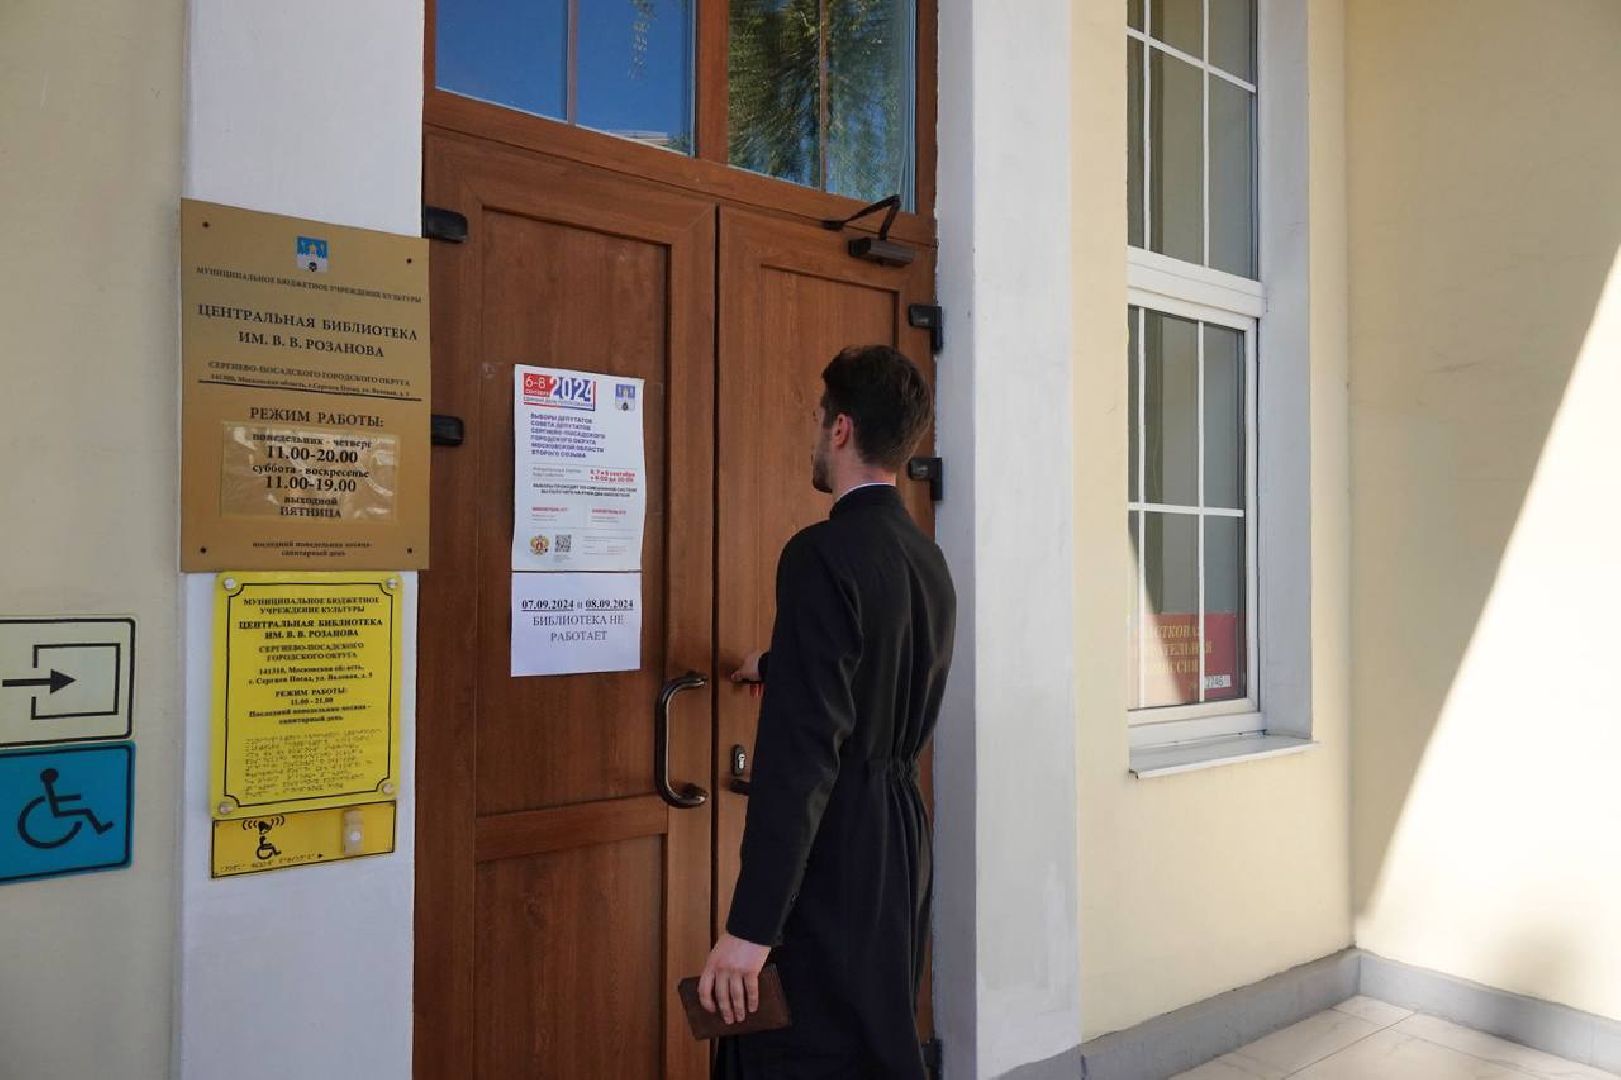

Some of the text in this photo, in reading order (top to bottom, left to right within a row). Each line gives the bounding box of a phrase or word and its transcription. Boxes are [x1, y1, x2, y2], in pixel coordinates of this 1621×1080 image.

[198, 304, 417, 340] ЦЕНТРАЛЬНАЯ БИБЛИОТЕКА
[239, 331, 384, 357] ИМ. В. В. РОЗАНОВА
[525, 376, 545, 389] 6-8
[550, 376, 593, 402] 2024
[250, 407, 383, 427] РЕЖИМ РАБОТЫ:
[267, 445, 358, 463] 11.00-20.00
[253, 463, 296, 474] суббота
[265, 476, 356, 492] 11.00-19.00
[281, 507, 341, 518] ПЯТНИЦА
[522, 600, 574, 609] 07.09.2024
[585, 600, 634, 608] 08.09.2024
[239, 618, 383, 629] ЦЕНТРАЛЬНАЯ БИБЛИОТЕКА
[533, 615, 624, 626] БИБЛИОТЕКА НЕ
[309, 629, 358, 638] РОЗАНОВА
[551, 631, 607, 641] РАБОТАЕТ
[276, 689, 309, 697] РЕЖИМ
